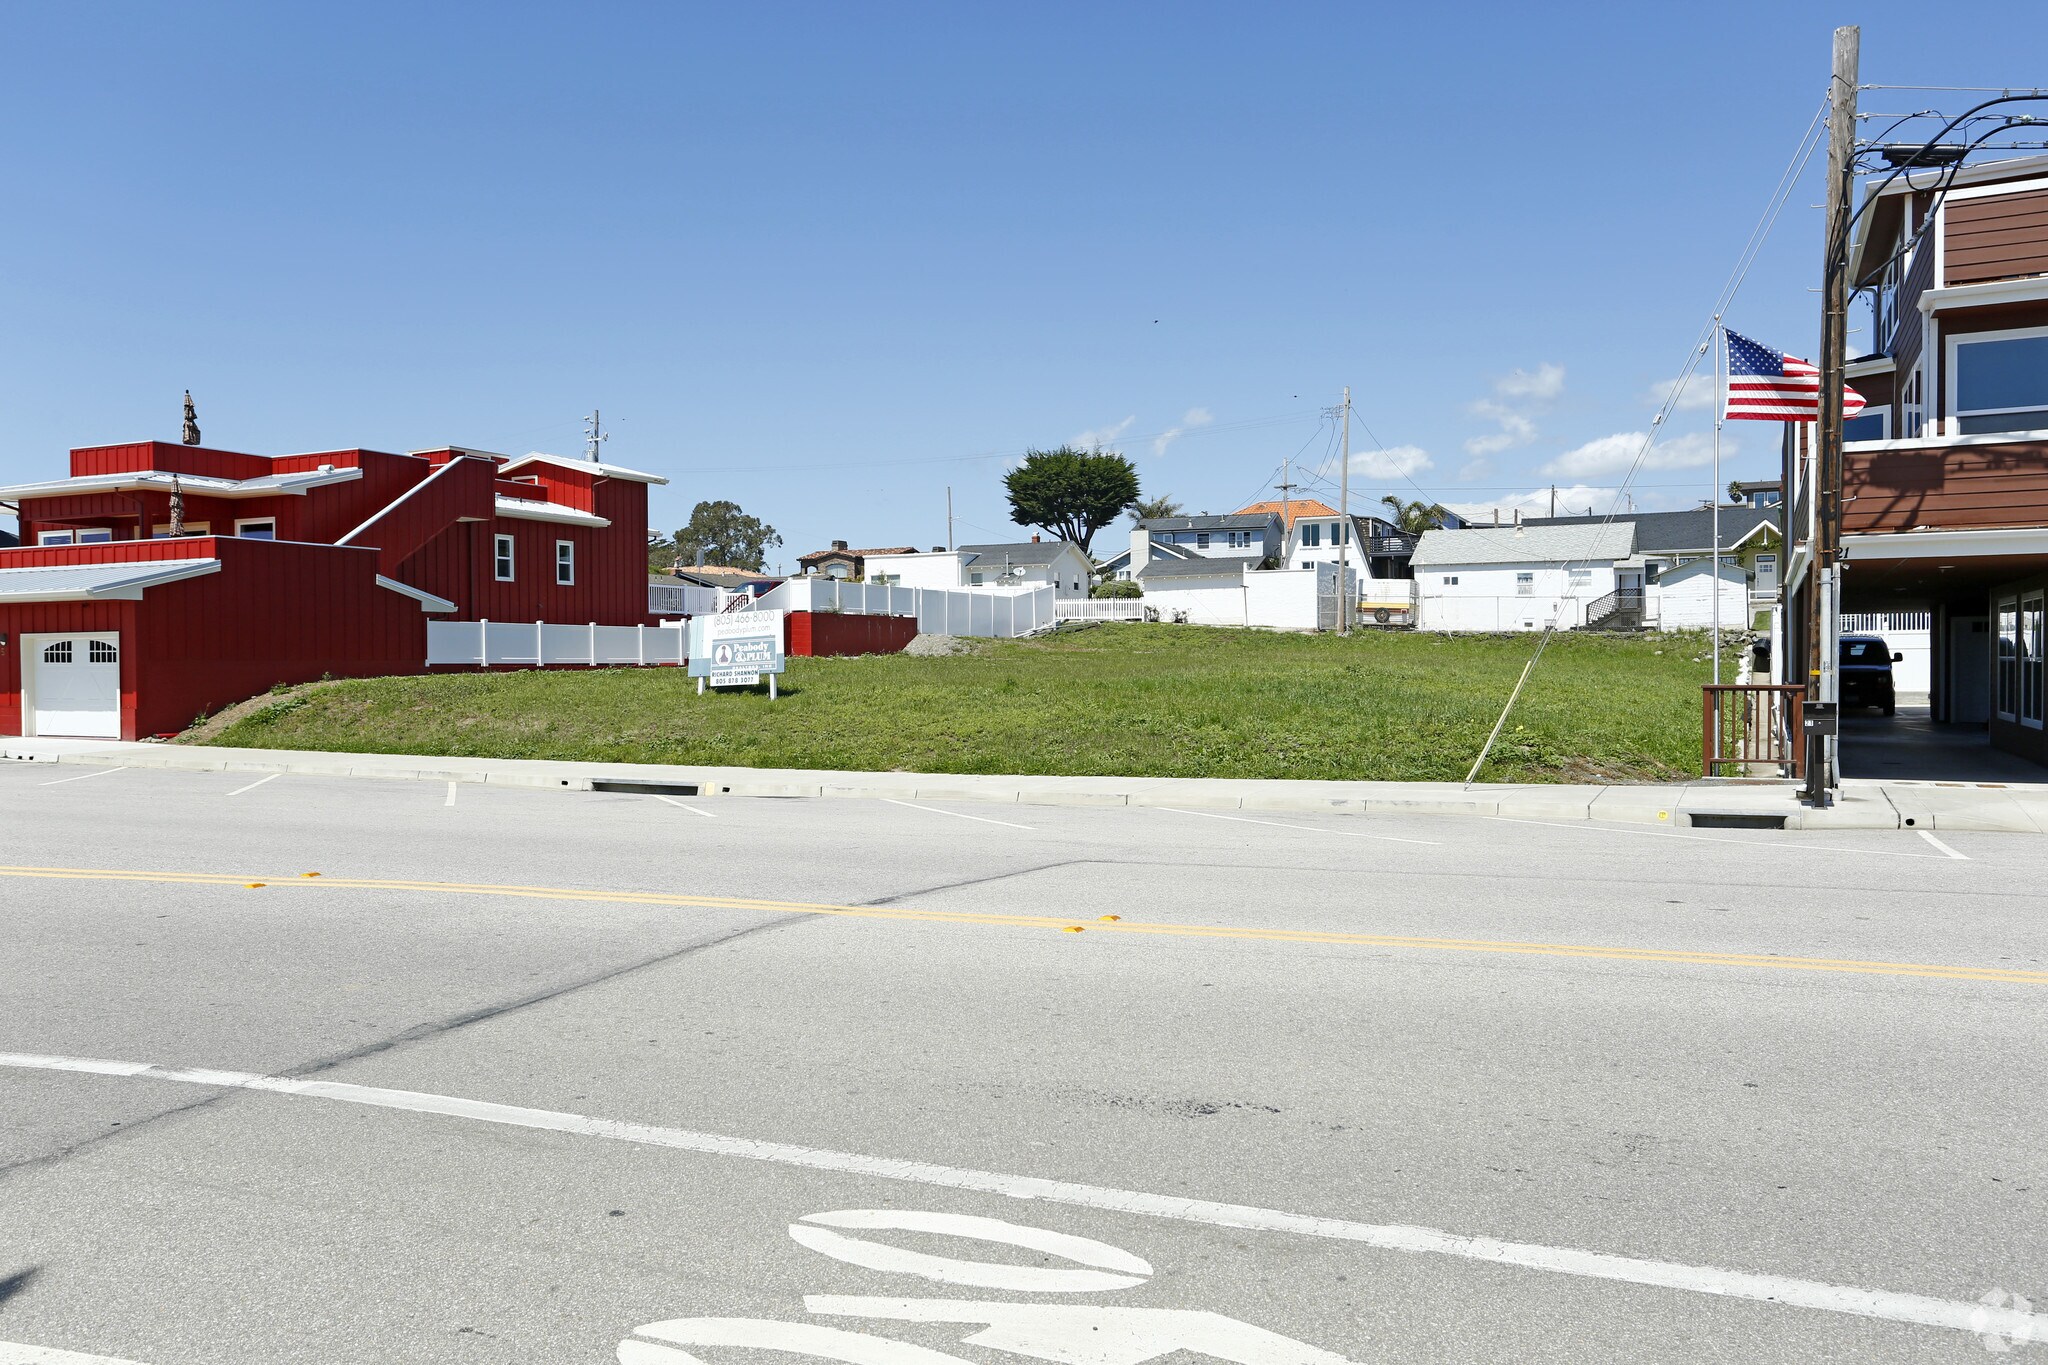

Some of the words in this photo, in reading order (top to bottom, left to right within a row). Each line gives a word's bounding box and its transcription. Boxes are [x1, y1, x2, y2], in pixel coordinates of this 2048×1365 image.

[714, 615, 733, 627] (805)
[735, 610, 774, 623] 466-8000
[717, 625, 770, 636] peabodyplum.com
[733, 641, 769, 652] Peabody
[735, 651, 746, 662] &
[746, 651, 771, 661] PLUM
